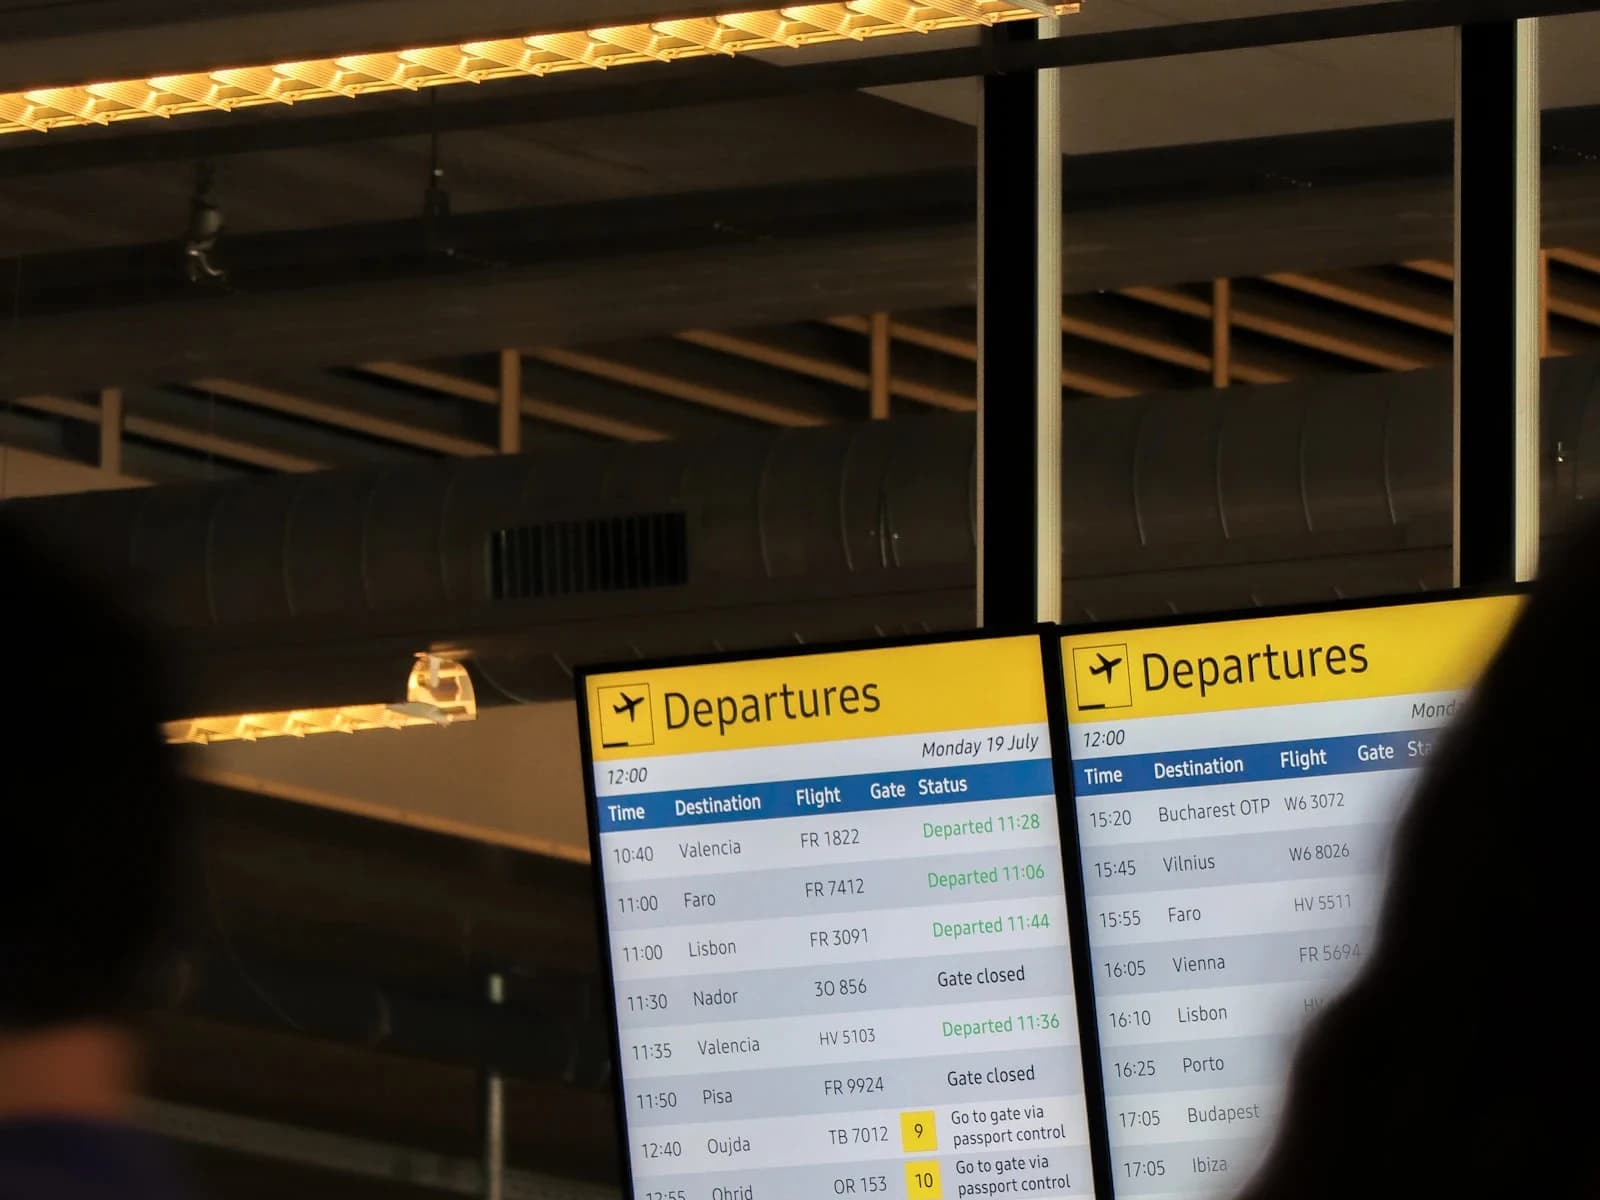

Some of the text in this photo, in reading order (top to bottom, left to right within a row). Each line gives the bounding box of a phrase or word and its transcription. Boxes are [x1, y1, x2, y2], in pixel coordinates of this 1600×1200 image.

[1143, 642, 1369, 698] Departures
[664, 683, 880, 736] Departures
[922, 732, 1039, 757] Monday 19 July
[1082, 729, 1125, 748] 12:00
[608, 766, 648, 784] 12:00
[1084, 744, 1394, 784] Time Destination Flight Gate
[608, 778, 967, 821] Time Destination Flight Gate Status
[1090, 793, 1344, 827] 15:20 Bucharest OTP W6 3072
[614, 814, 1040, 863] 10:40 Valencia FR 1822 Departed 11:28
[1095, 843, 1349, 877] 15:45 Vilnius W6 8026
[619, 864, 1044, 912] 11:00 Faro FR 7412 Departed 11:06
[1100, 907, 1200, 927] 15:55 Faro
[624, 914, 1050, 961] 11:00 Lisbon FR 3091 Departed 11:44
[1104, 957, 1225, 977] 16:05 Vienna
[628, 965, 1024, 1011] 11:30 Nador 856 Gate closed
[1109, 1006, 1227, 1027] 16:10 Lisbon
[632, 1014, 1059, 1060] 11:35 Valencia HV 5103 Departed 11:36
[1115, 1057, 1224, 1077] 16:25 Porto
[637, 1064, 1035, 1109] 11:50 Pisa FR 9924 Gate closed
[952, 1105, 1044, 1126] Go to gate via
[1120, 1110, 1160, 1127] 17:05
[642, 1123, 923, 1158] 12:40 Oujda TB 7012 9
[953, 1124, 1066, 1149] passport control
[956, 1154, 1049, 1175] Go to gate via
[1124, 1160, 1165, 1177] 17:05
[834, 1179, 855, 1194] OR
[861, 1176, 886, 1192] 153
[915, 1172, 933, 1188] 10
[958, 1174, 1071, 1199] passport control
